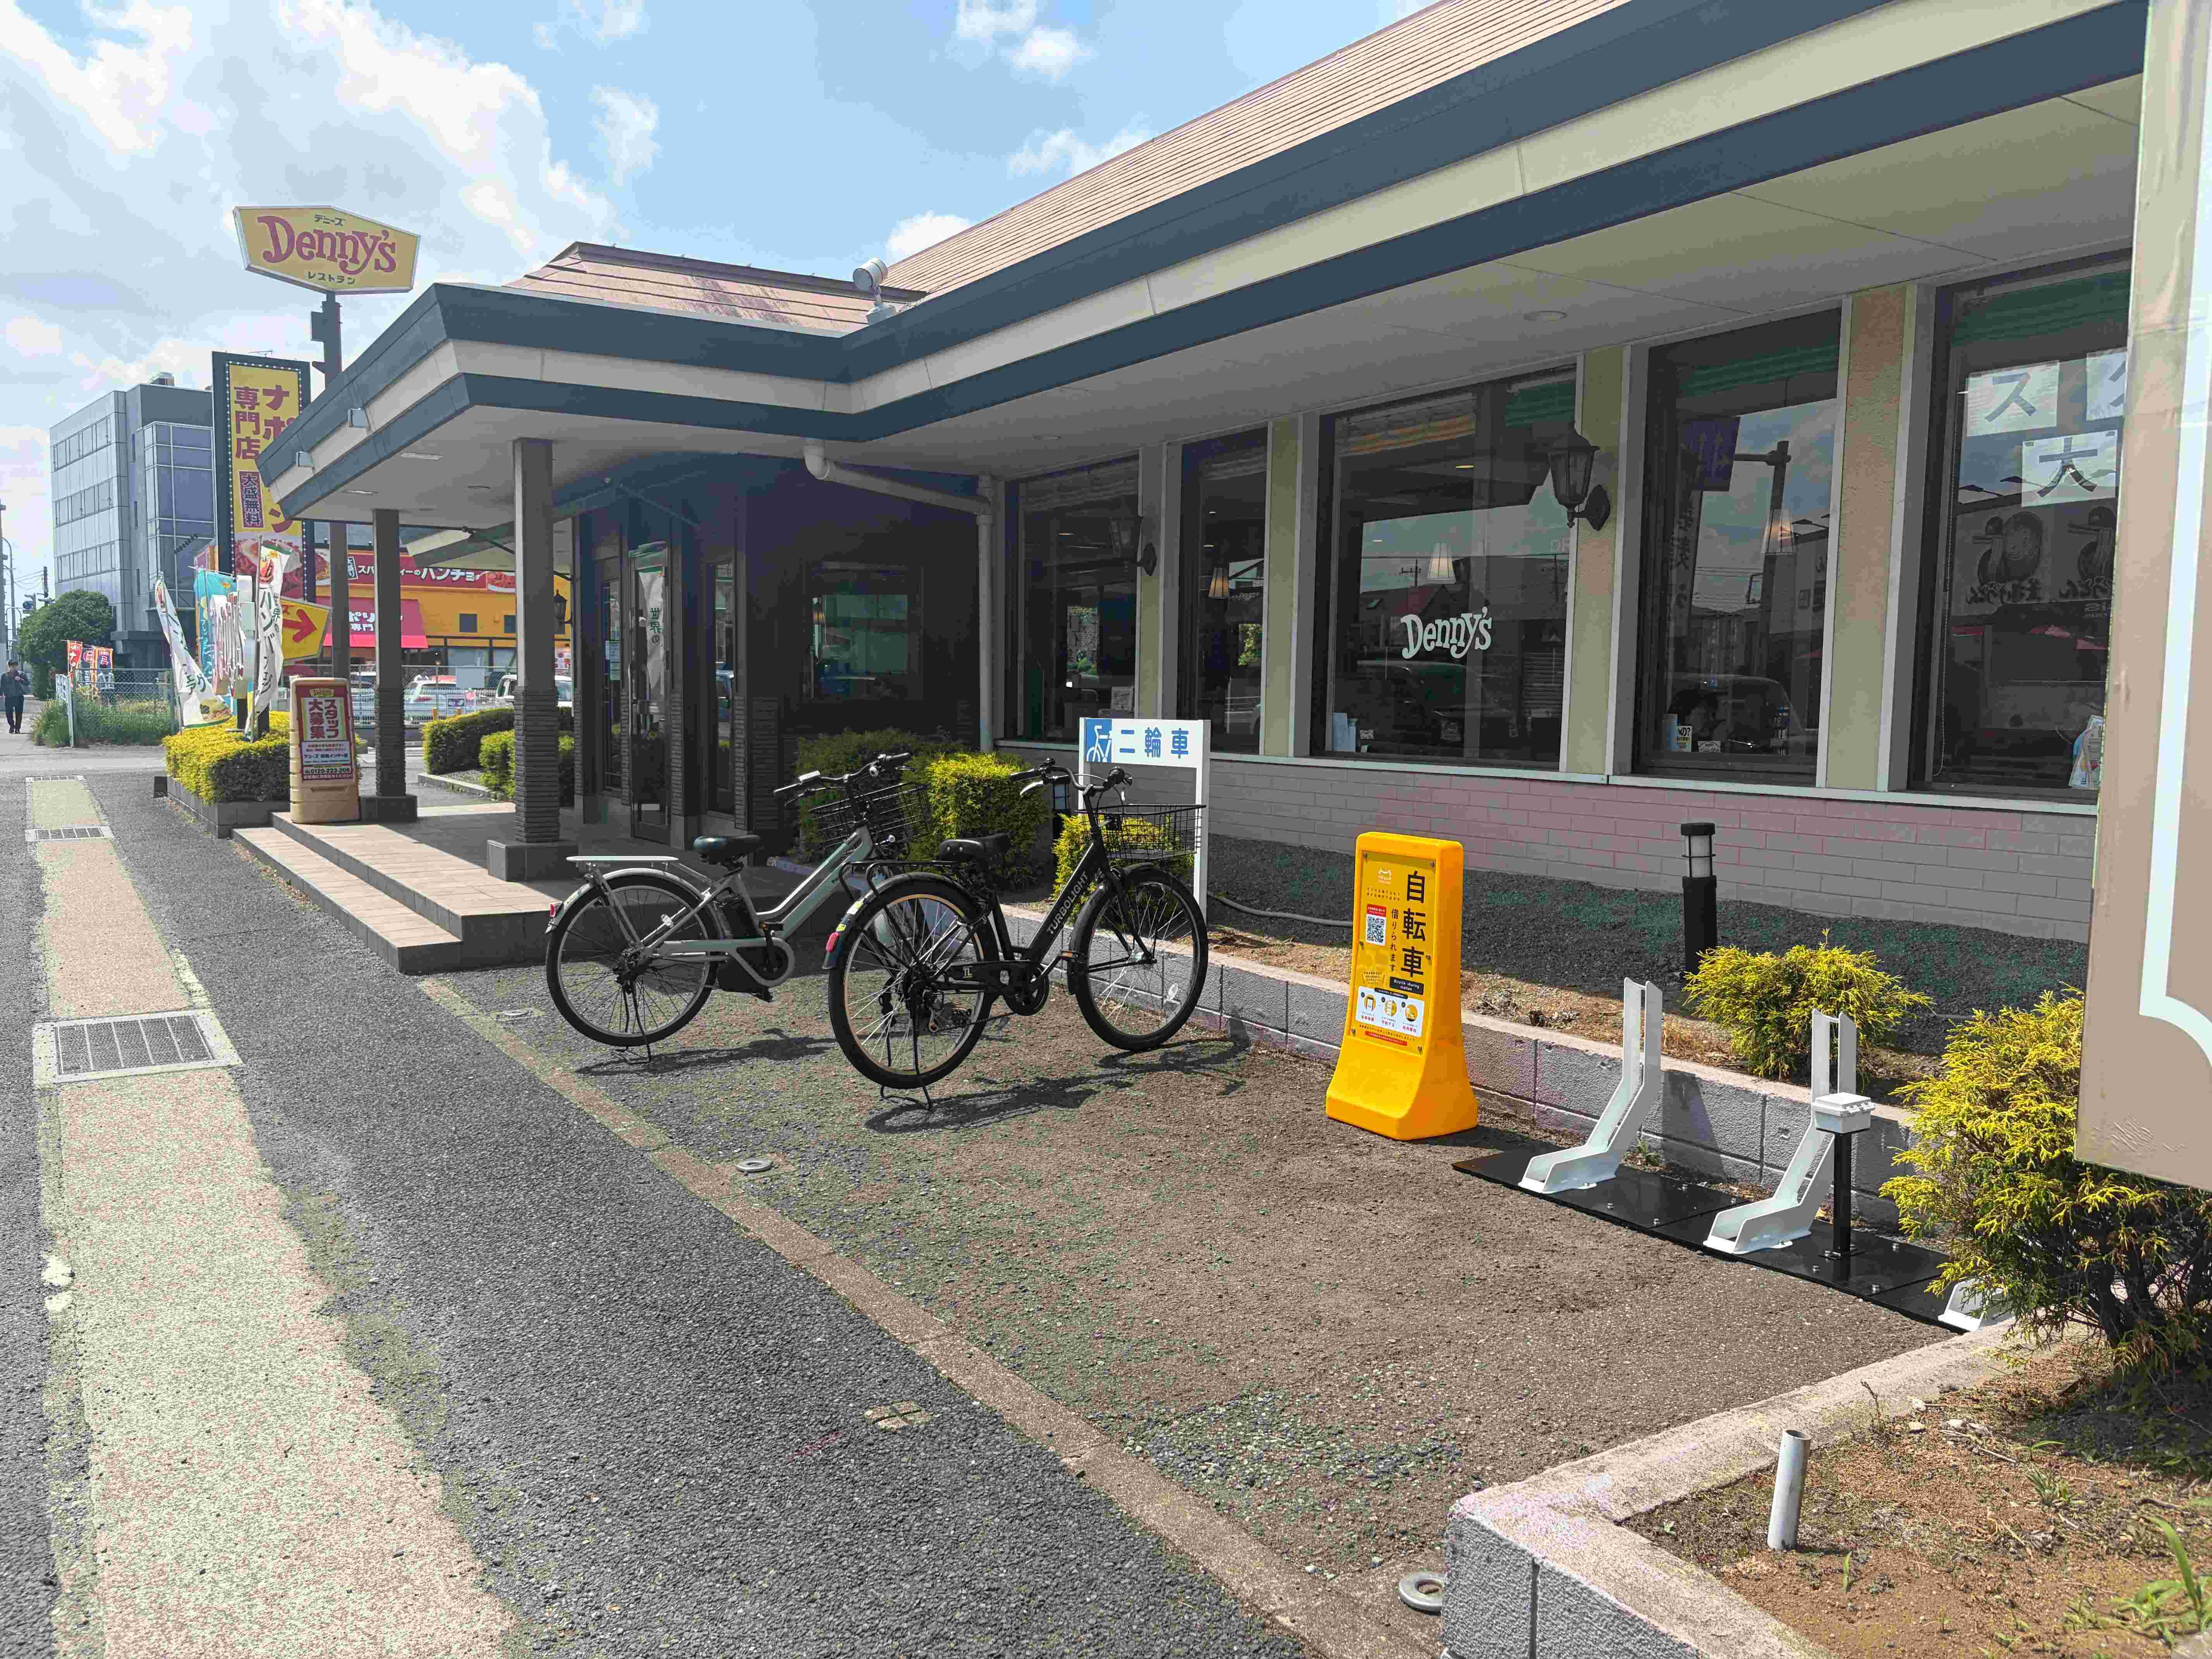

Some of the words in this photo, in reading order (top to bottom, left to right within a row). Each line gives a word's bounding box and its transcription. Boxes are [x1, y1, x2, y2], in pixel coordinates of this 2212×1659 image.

[257, 215, 396, 275] Denny's
[314, 214, 347, 226] デニーズ
[308, 271, 356, 285] レストラン
[234, 386, 260, 459] 専門店
[2036, 436, 2098, 498] 大
[241, 473, 261, 526] 大盛無料
[1400, 606, 1492, 659] Denny's
[309, 699, 325, 739] 大募集
[325, 699, 338, 738] スタッフ
[1119, 727, 1189, 759] 二輪車
[1047, 870, 1088, 934] TURBOLIGHT
[1400, 870, 1426, 978] 自転車
[1390, 908, 1400, 973] 借りられます
[1407, 981, 1419, 989] sharing
